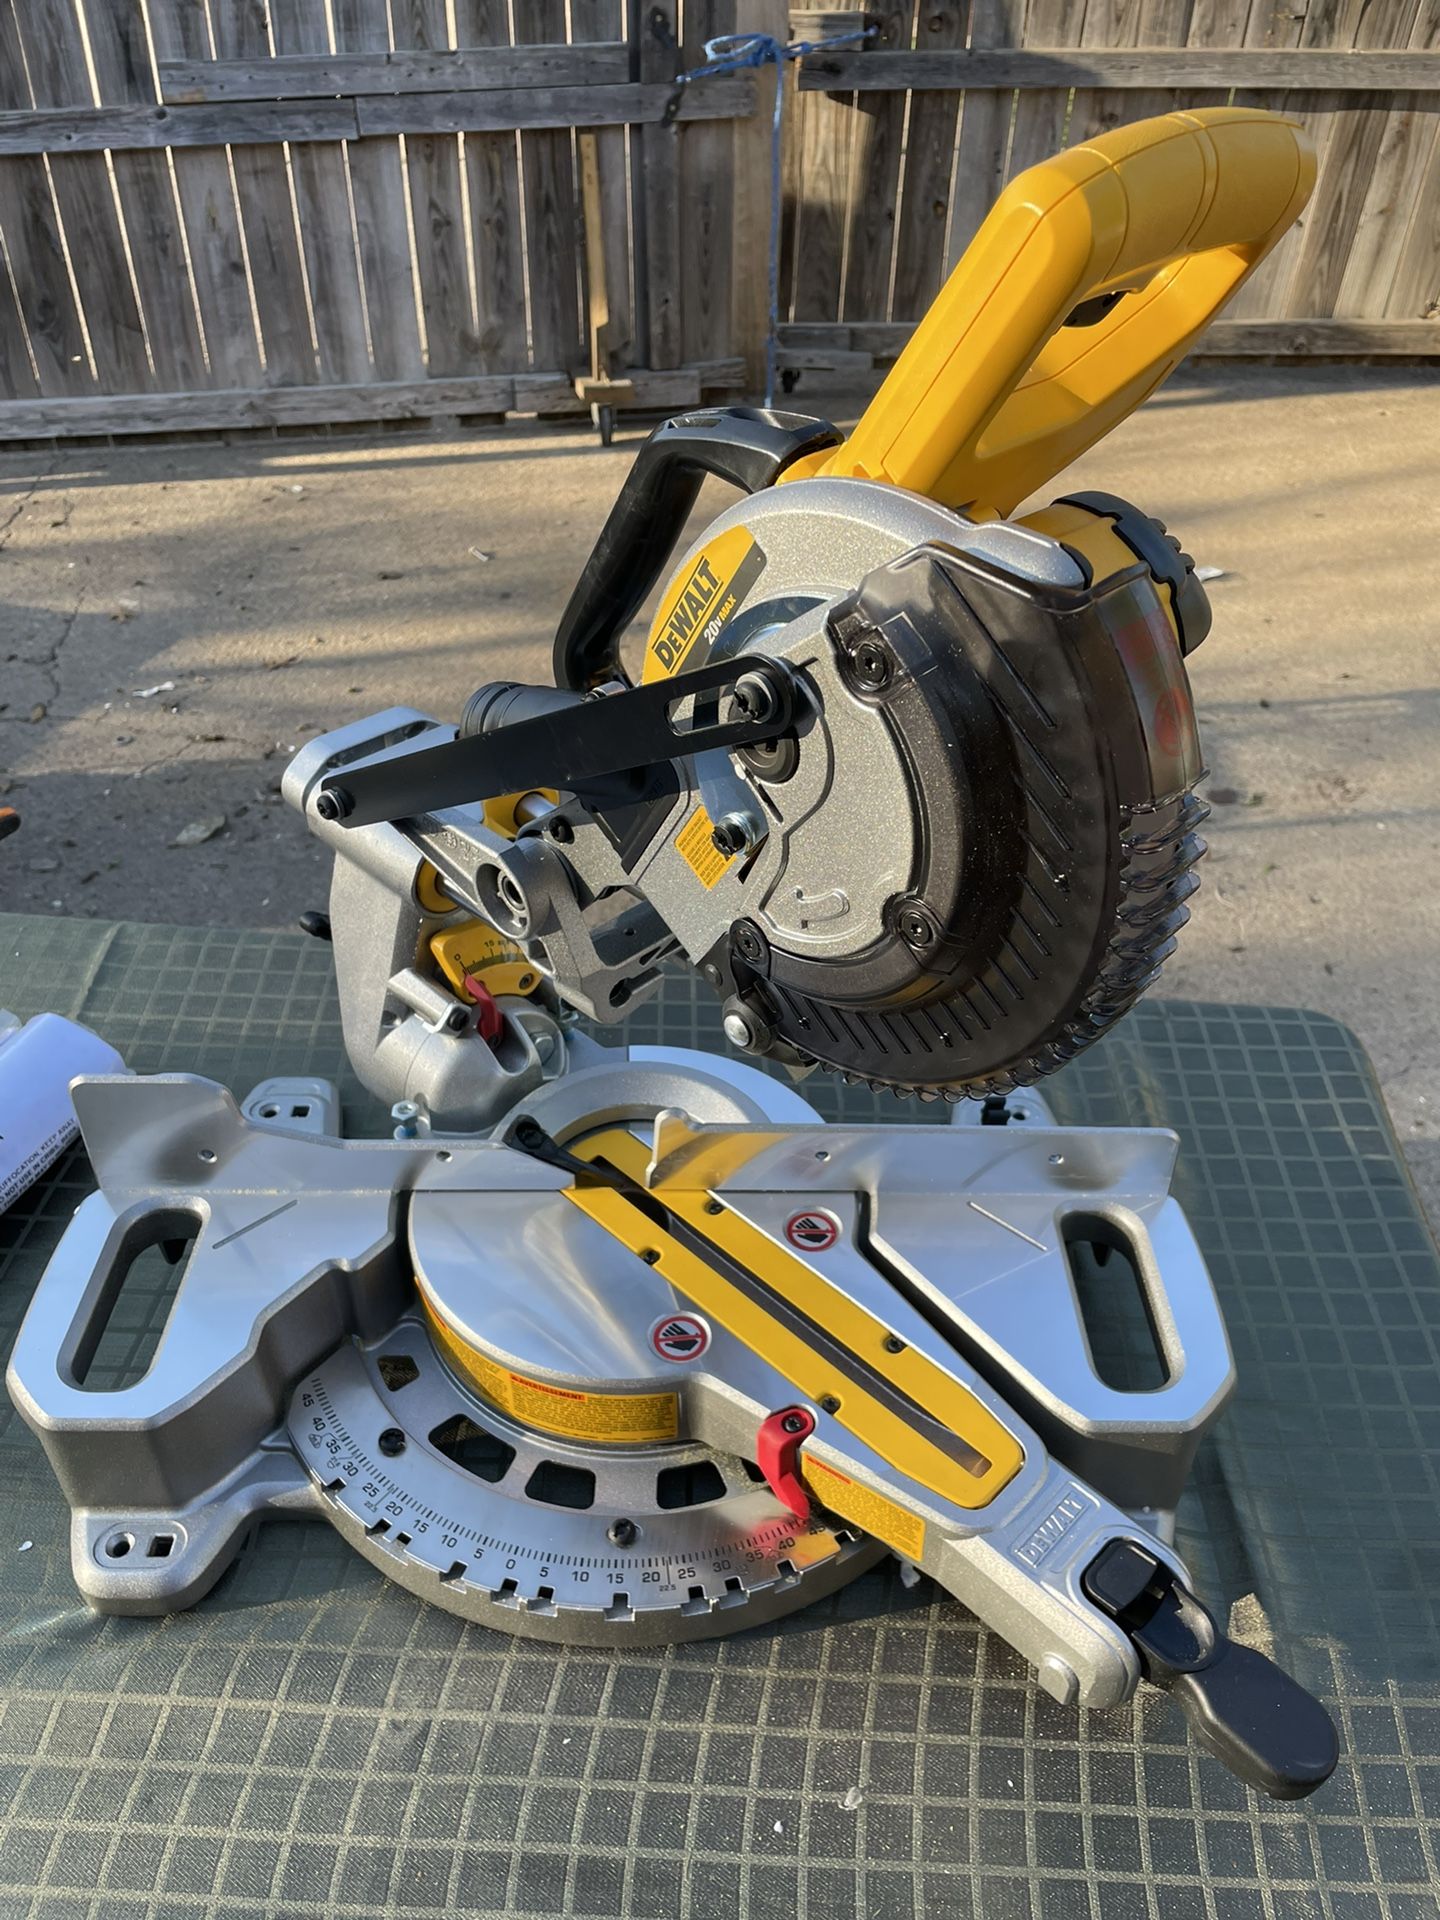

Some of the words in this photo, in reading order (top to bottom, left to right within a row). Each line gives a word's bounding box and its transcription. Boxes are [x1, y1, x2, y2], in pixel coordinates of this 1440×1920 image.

[720, 593, 737, 622] MAX
[453, 953, 461, 962] 0
[484, 939, 495, 948] 15
[5, 1182, 19, 1197] NOT
[19, 1169, 32, 1184] USE
[302, 1393, 314, 1408] 45
[312, 1416, 326, 1431] 40
[326, 1439, 341, 1454] 35
[343, 1461, 358, 1477] 30
[362, 1483, 380, 1498] 25
[386, 1501, 403, 1516] 20
[414, 1519, 430, 1533] 15
[441, 1534, 458, 1548] 10
[473, 1548, 485, 1559] 5
[505, 1558, 517, 1570] 0
[539, 1567, 549, 1577] 5
[572, 1571, 590, 1582] 10
[607, 1573, 624, 1584] 15
[642, 1571, 661, 1583] 20
[678, 1568, 696, 1579] 25
[713, 1559, 732, 1572] 30
[746, 1550, 764, 1563] 35
[778, 1537, 796, 1551] 40
[808, 1524, 826, 1536] 45
